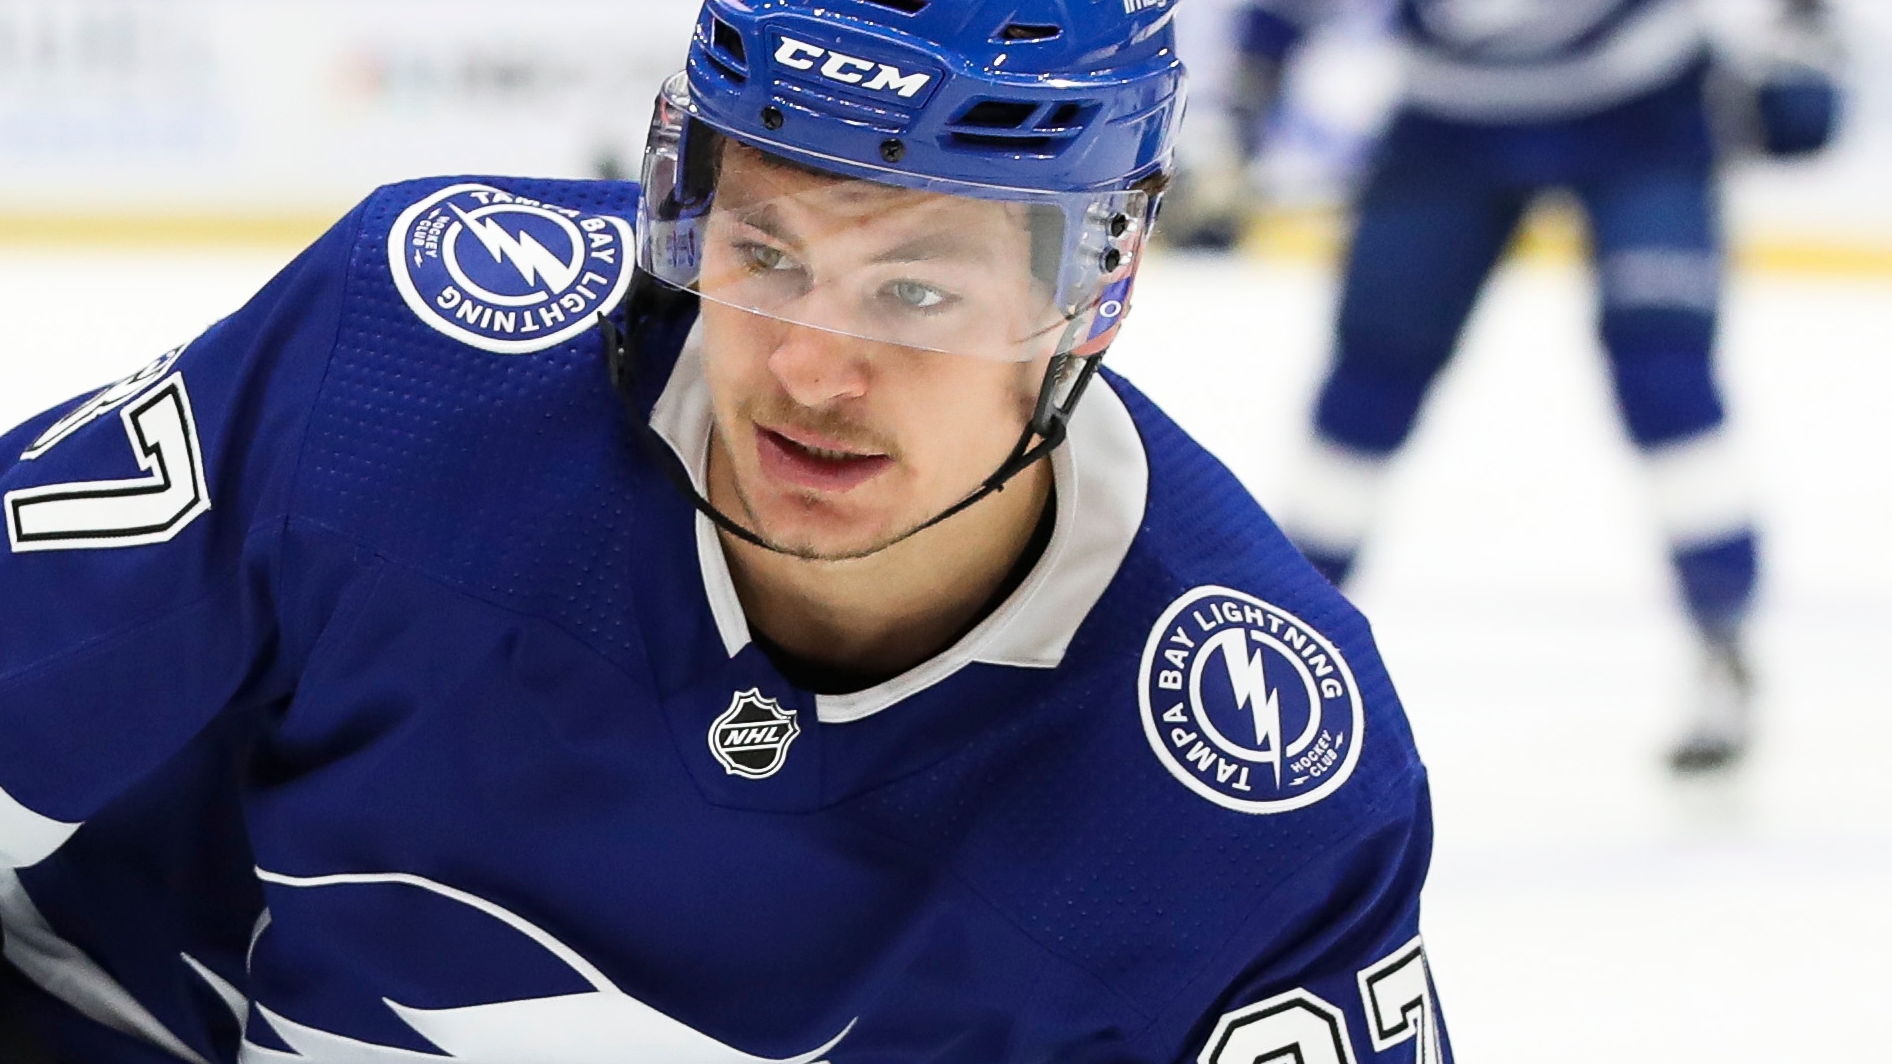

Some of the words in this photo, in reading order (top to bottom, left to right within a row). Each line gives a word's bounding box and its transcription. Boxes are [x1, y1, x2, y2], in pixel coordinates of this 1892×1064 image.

[774, 36, 931, 98] CCM
[412, 219, 431, 248] CLUB
[425, 215, 451, 259] HOCKEY
[580, 216, 615, 264] BAY
[437, 271, 608, 334] LIGHTNING
[1158, 626, 1195, 690] BAY
[1193, 601, 1344, 699] LIGHTNING
[723, 726, 780, 746] NHL
[1162, 701, 1252, 792] TAMPA
[1290, 729, 1333, 774] HOCKEY
[1309, 749, 1338, 777] CLUB
